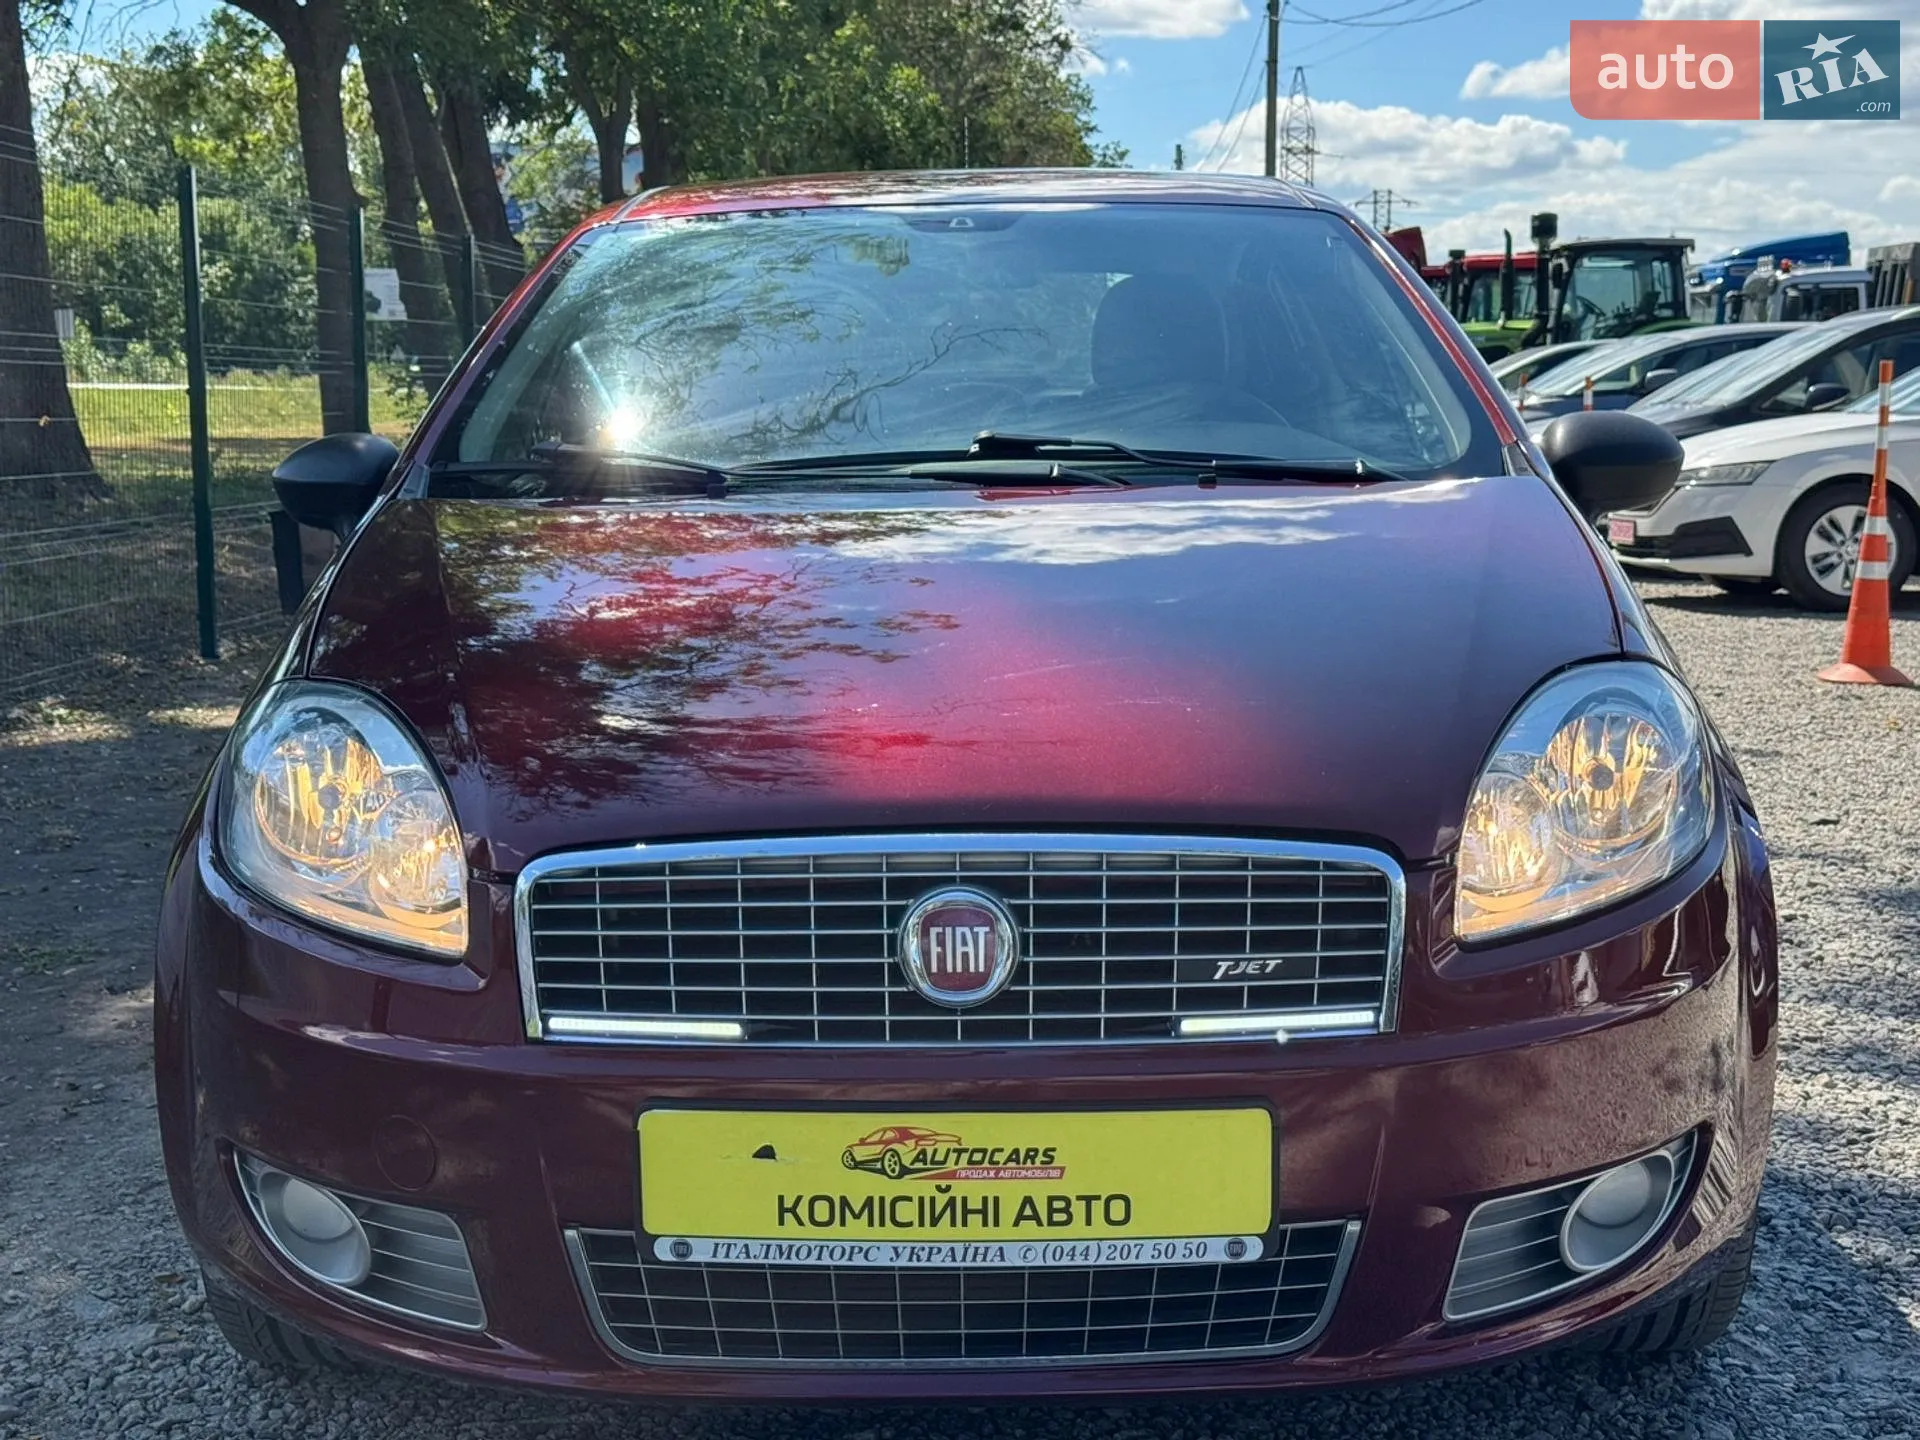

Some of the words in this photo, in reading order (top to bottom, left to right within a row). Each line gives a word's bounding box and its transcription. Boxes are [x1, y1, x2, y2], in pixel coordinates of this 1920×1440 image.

[929, 926, 991, 974] FIAT
[909, 1146, 1058, 1167] AUTOCARS
[956, 1168, 996, 1179] ПРОДАЖ
[998, 1168, 1062, 1179] АВТОМОБІЛІВ
[777, 1184, 1000, 1229] КОМІСІЙНІ
[1012, 1193, 1132, 1228] АВТО
[711, 1241, 881, 1263] ІТАЛМОТОРС
[888, 1241, 1007, 1264] УКРАЇНА
